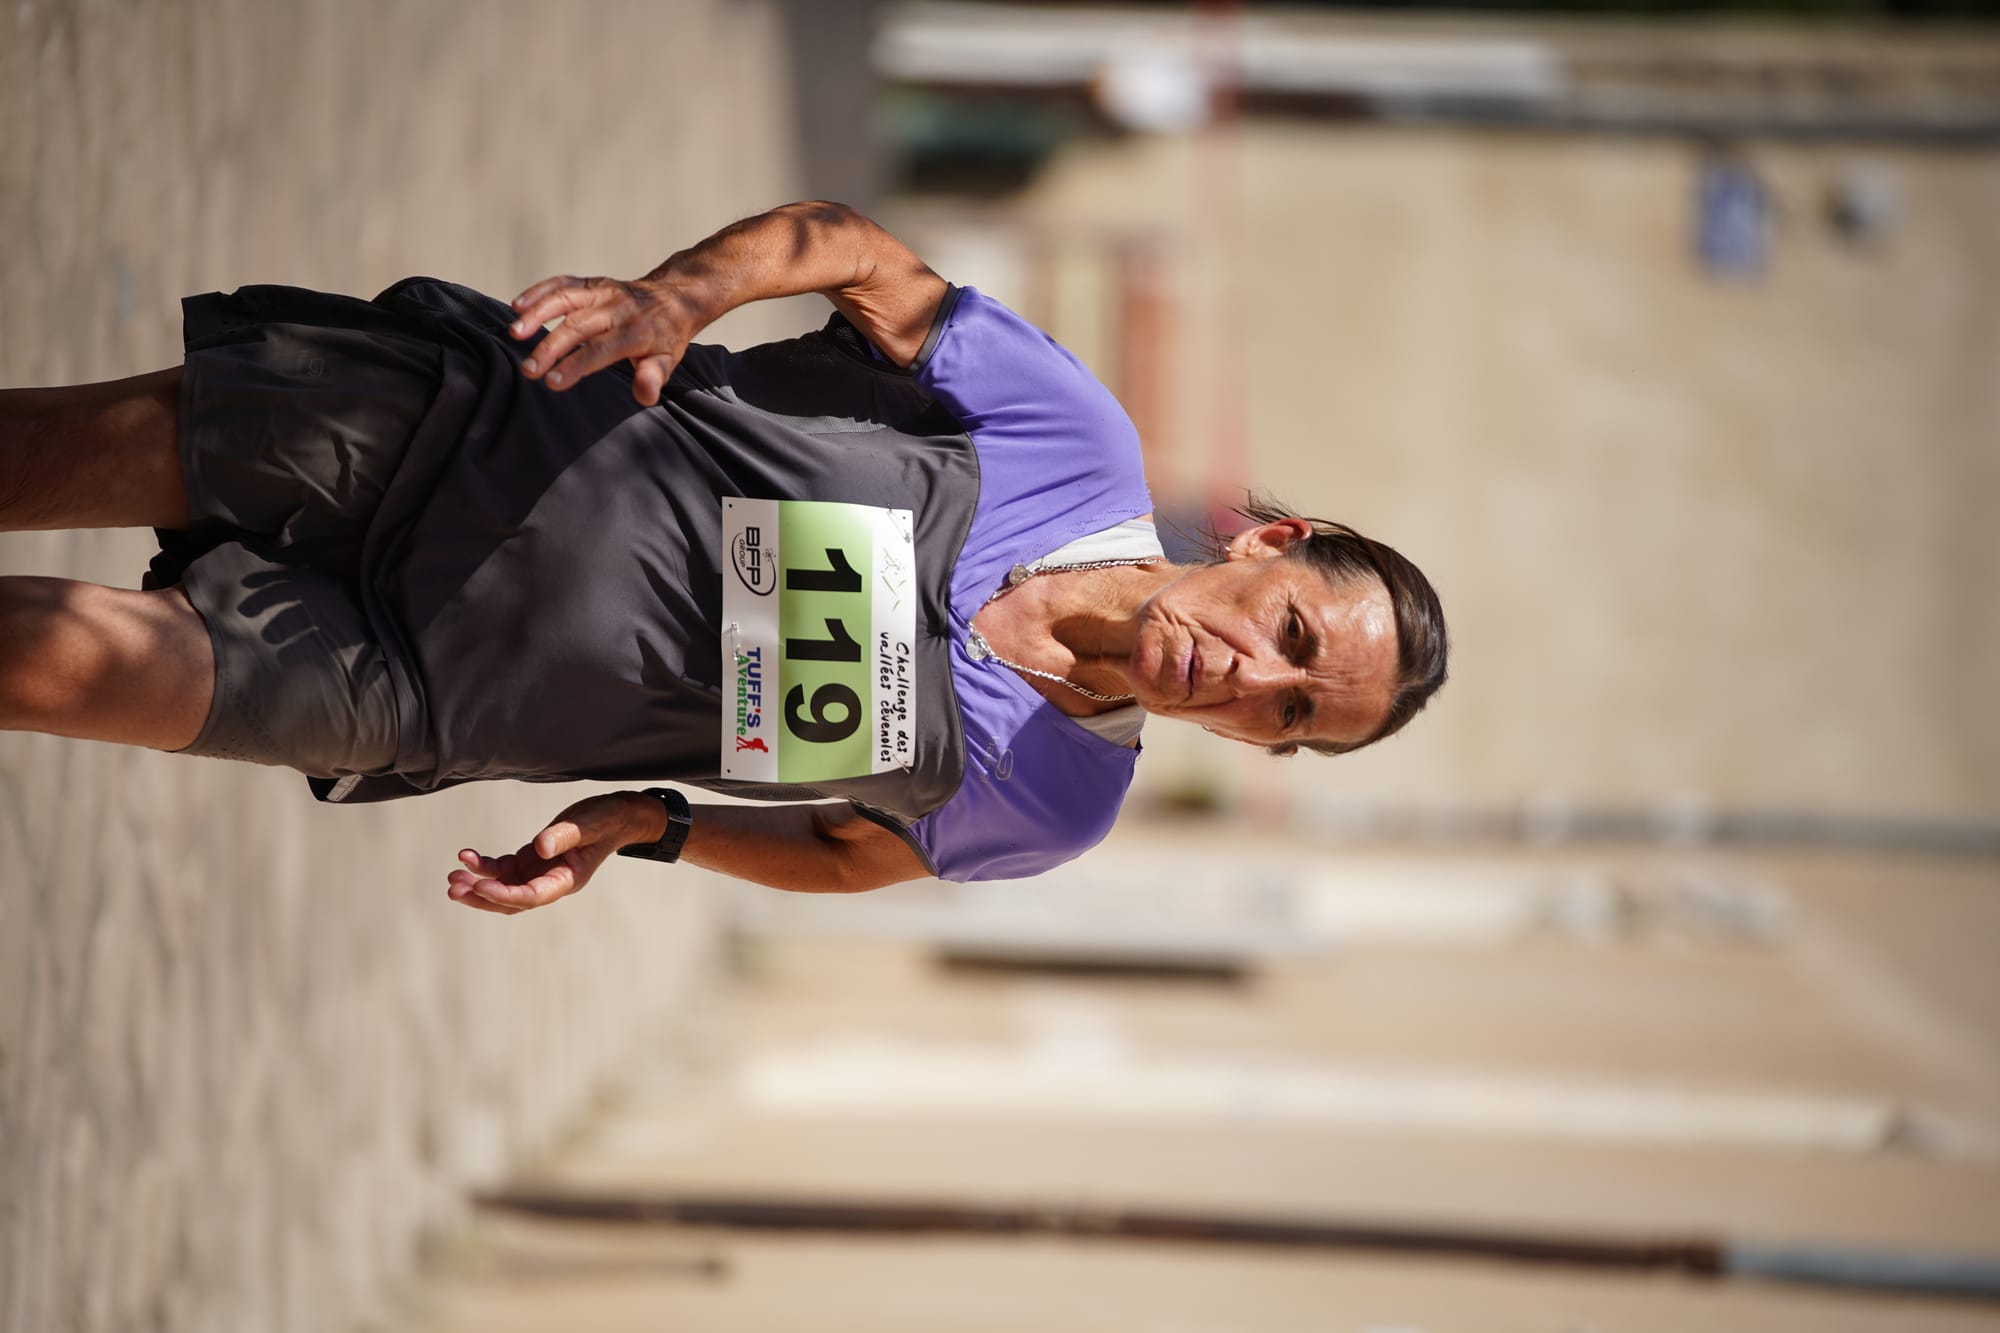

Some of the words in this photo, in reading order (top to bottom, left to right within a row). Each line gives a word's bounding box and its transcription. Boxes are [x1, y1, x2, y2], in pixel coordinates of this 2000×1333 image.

[738, 538, 746, 568] GROUP
[745, 526, 761, 586] BFP
[784, 547, 863, 744] 119
[880, 631, 894, 690] vallées
[736, 653, 751, 736] Aventure
[746, 646, 762, 729] TUFF'S
[893, 641, 910, 721] Challenge
[880, 700, 894, 763] cévenoles
[896, 730, 909, 754] des
